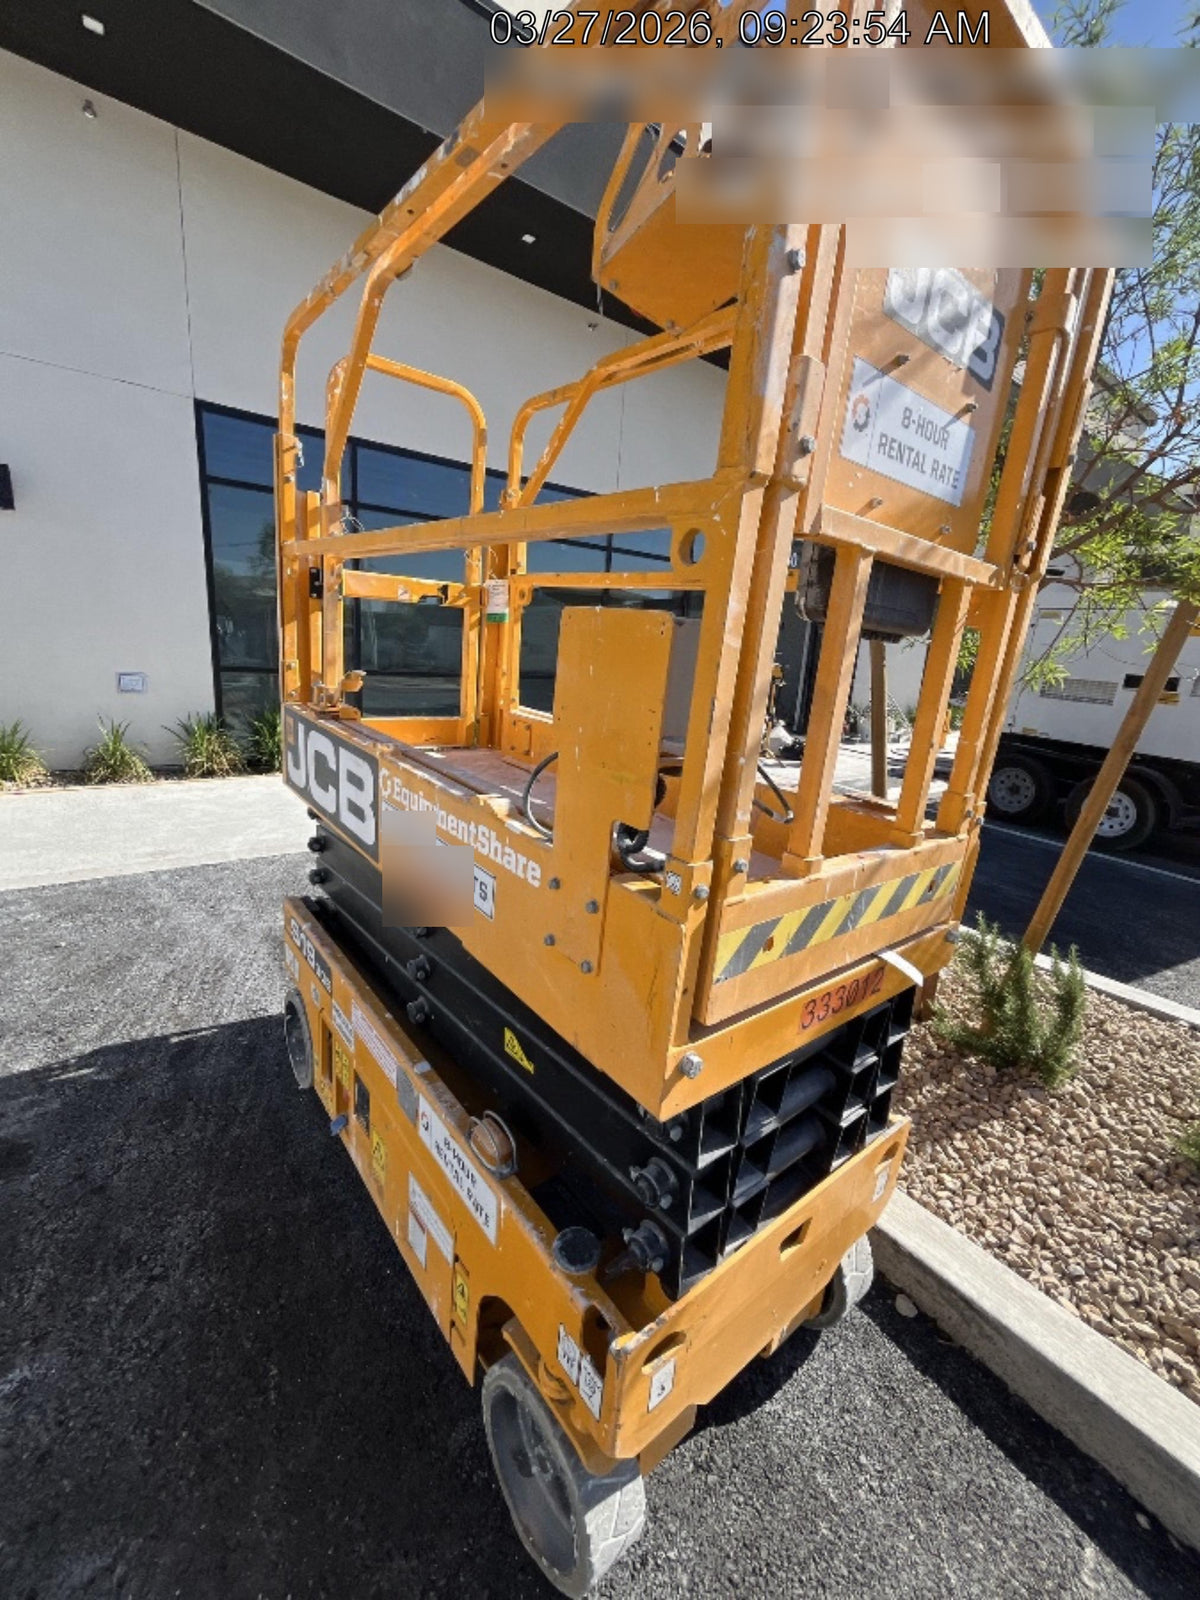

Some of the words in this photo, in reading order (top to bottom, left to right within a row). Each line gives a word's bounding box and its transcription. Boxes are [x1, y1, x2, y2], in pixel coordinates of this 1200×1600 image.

[901, 406, 950, 451] 8-HOUR
[878, 432, 927, 474] RENTAL
[930, 458, 960, 490] RATE
[287, 722, 376, 846] JCB
[801, 967, 885, 1030] 333012
